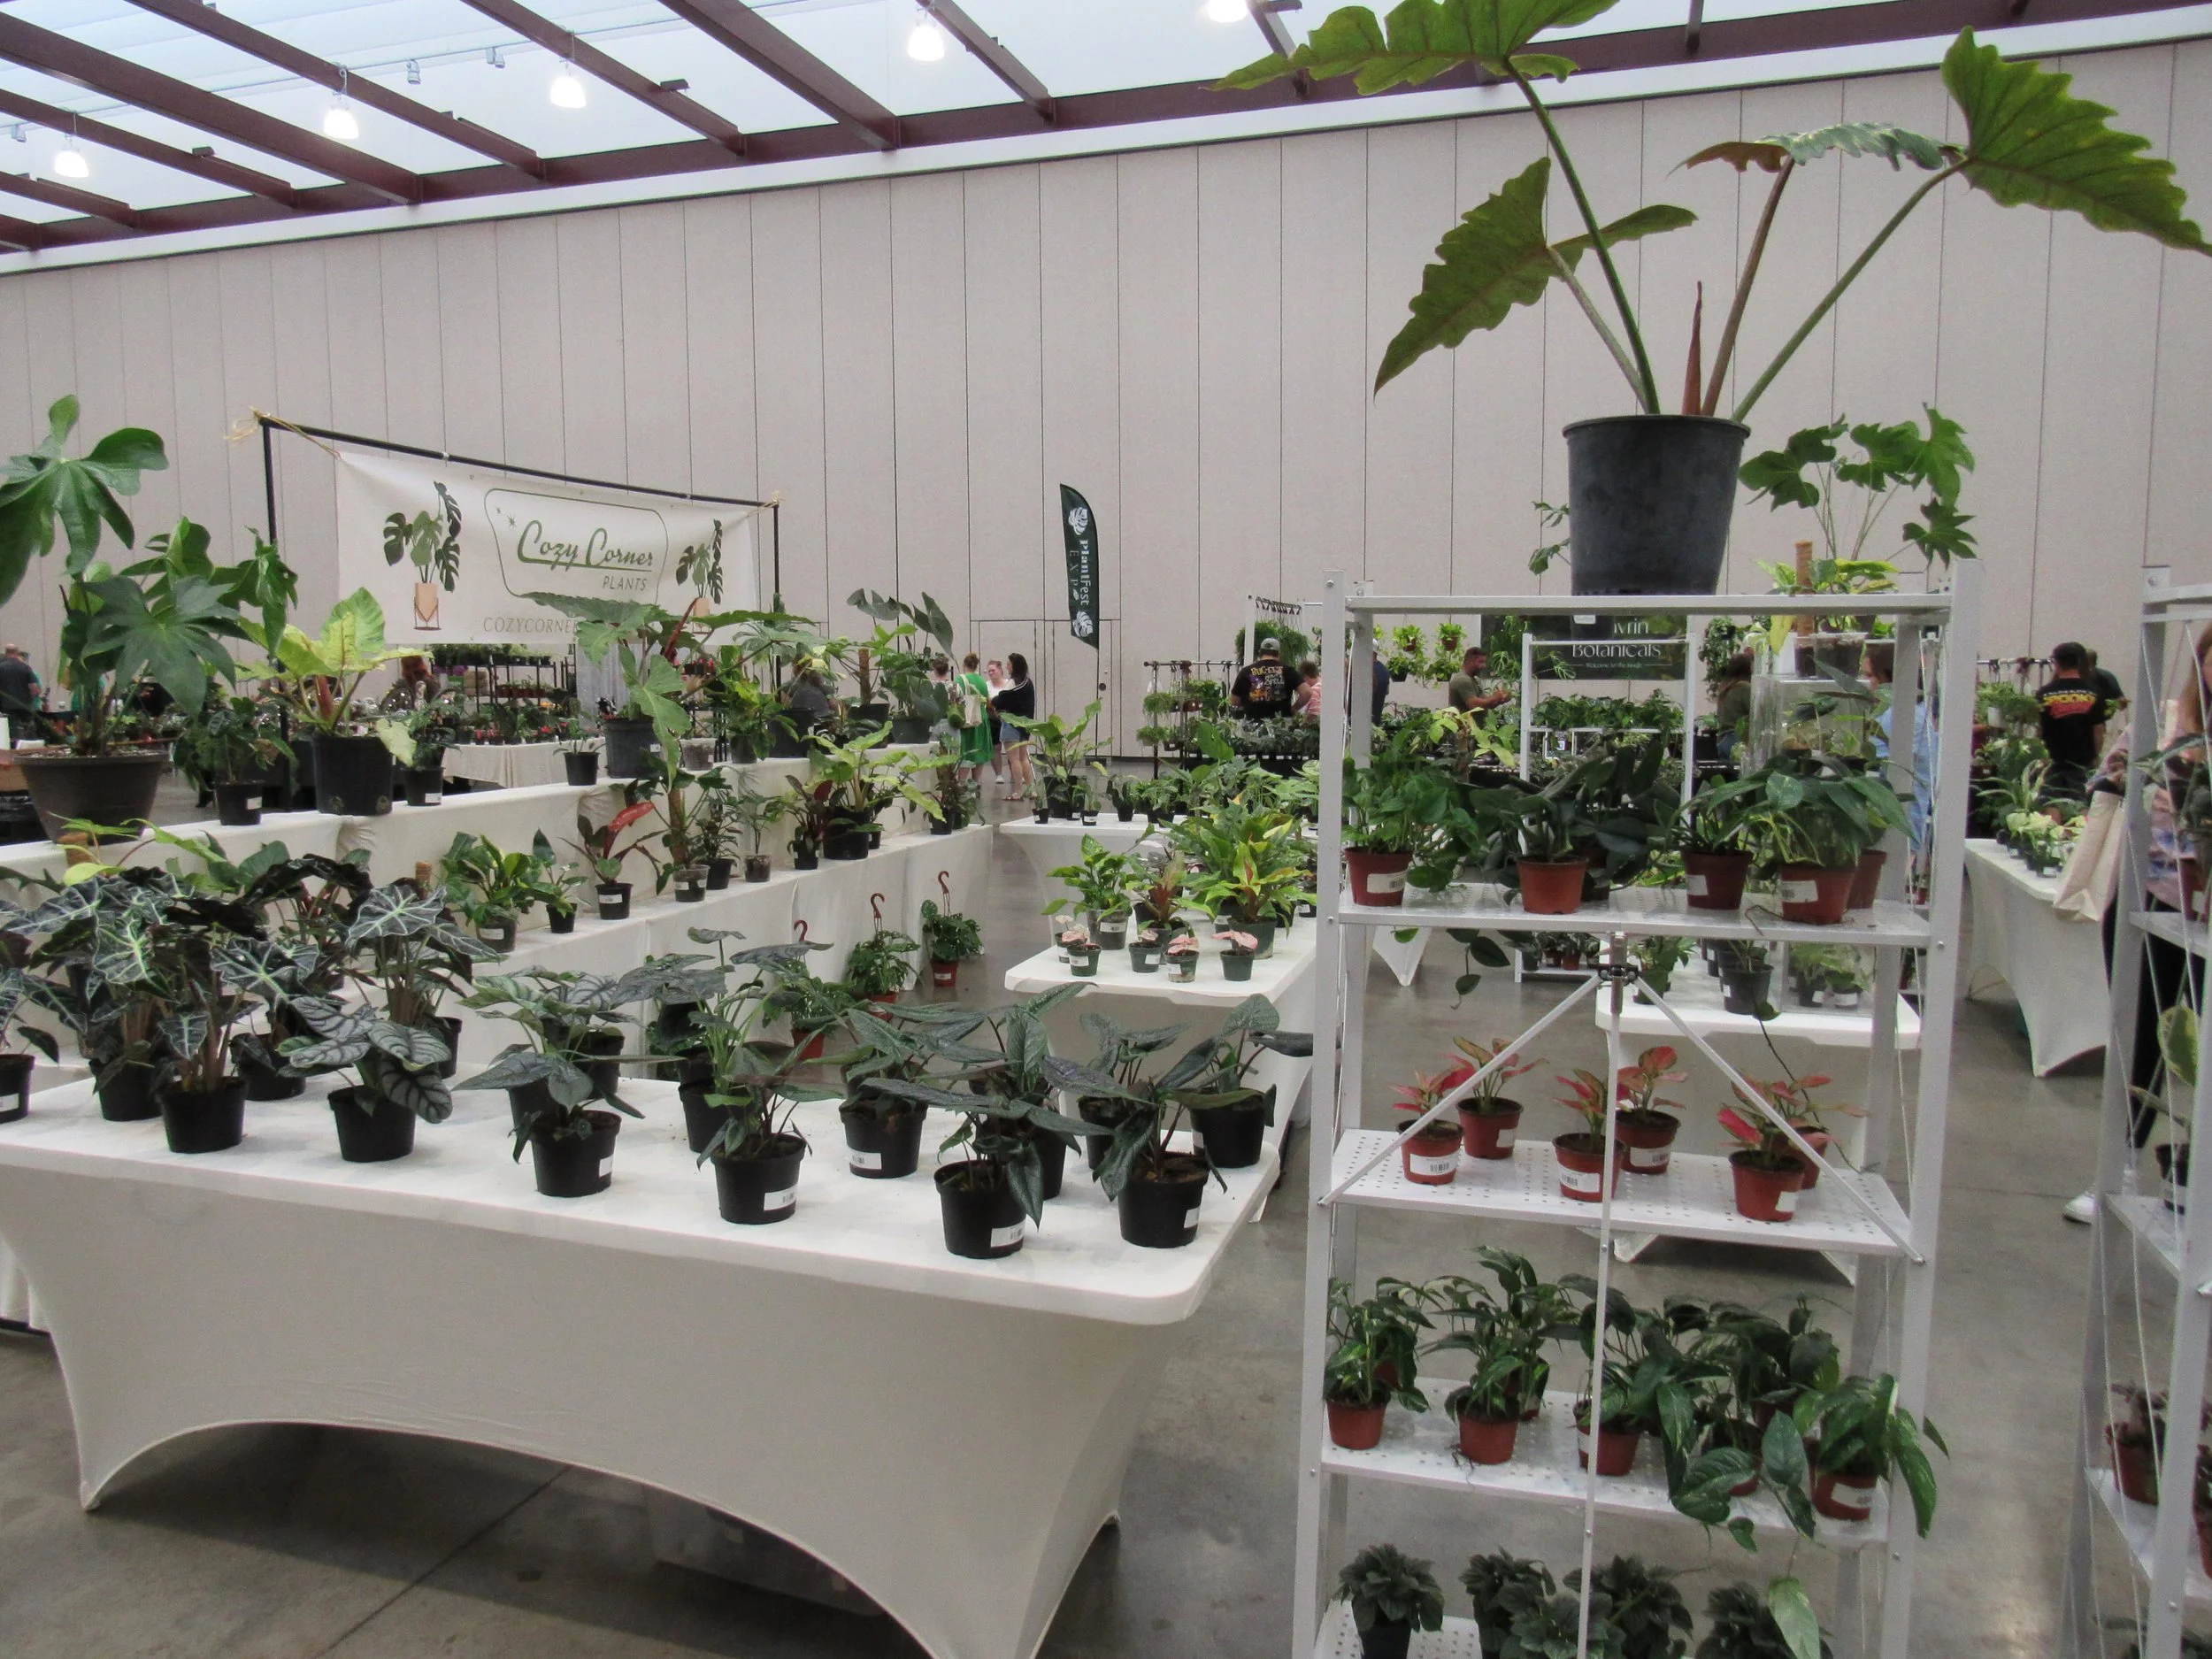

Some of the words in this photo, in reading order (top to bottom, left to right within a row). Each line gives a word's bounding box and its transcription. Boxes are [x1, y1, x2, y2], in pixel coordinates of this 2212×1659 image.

[518, 519, 579, 572] Cozy
[586, 527, 653, 568] Corner
[603, 575, 648, 591] PLANTS
[1079, 540, 1091, 605] PlantFest
[1572, 644, 1662, 658] Botanicals
